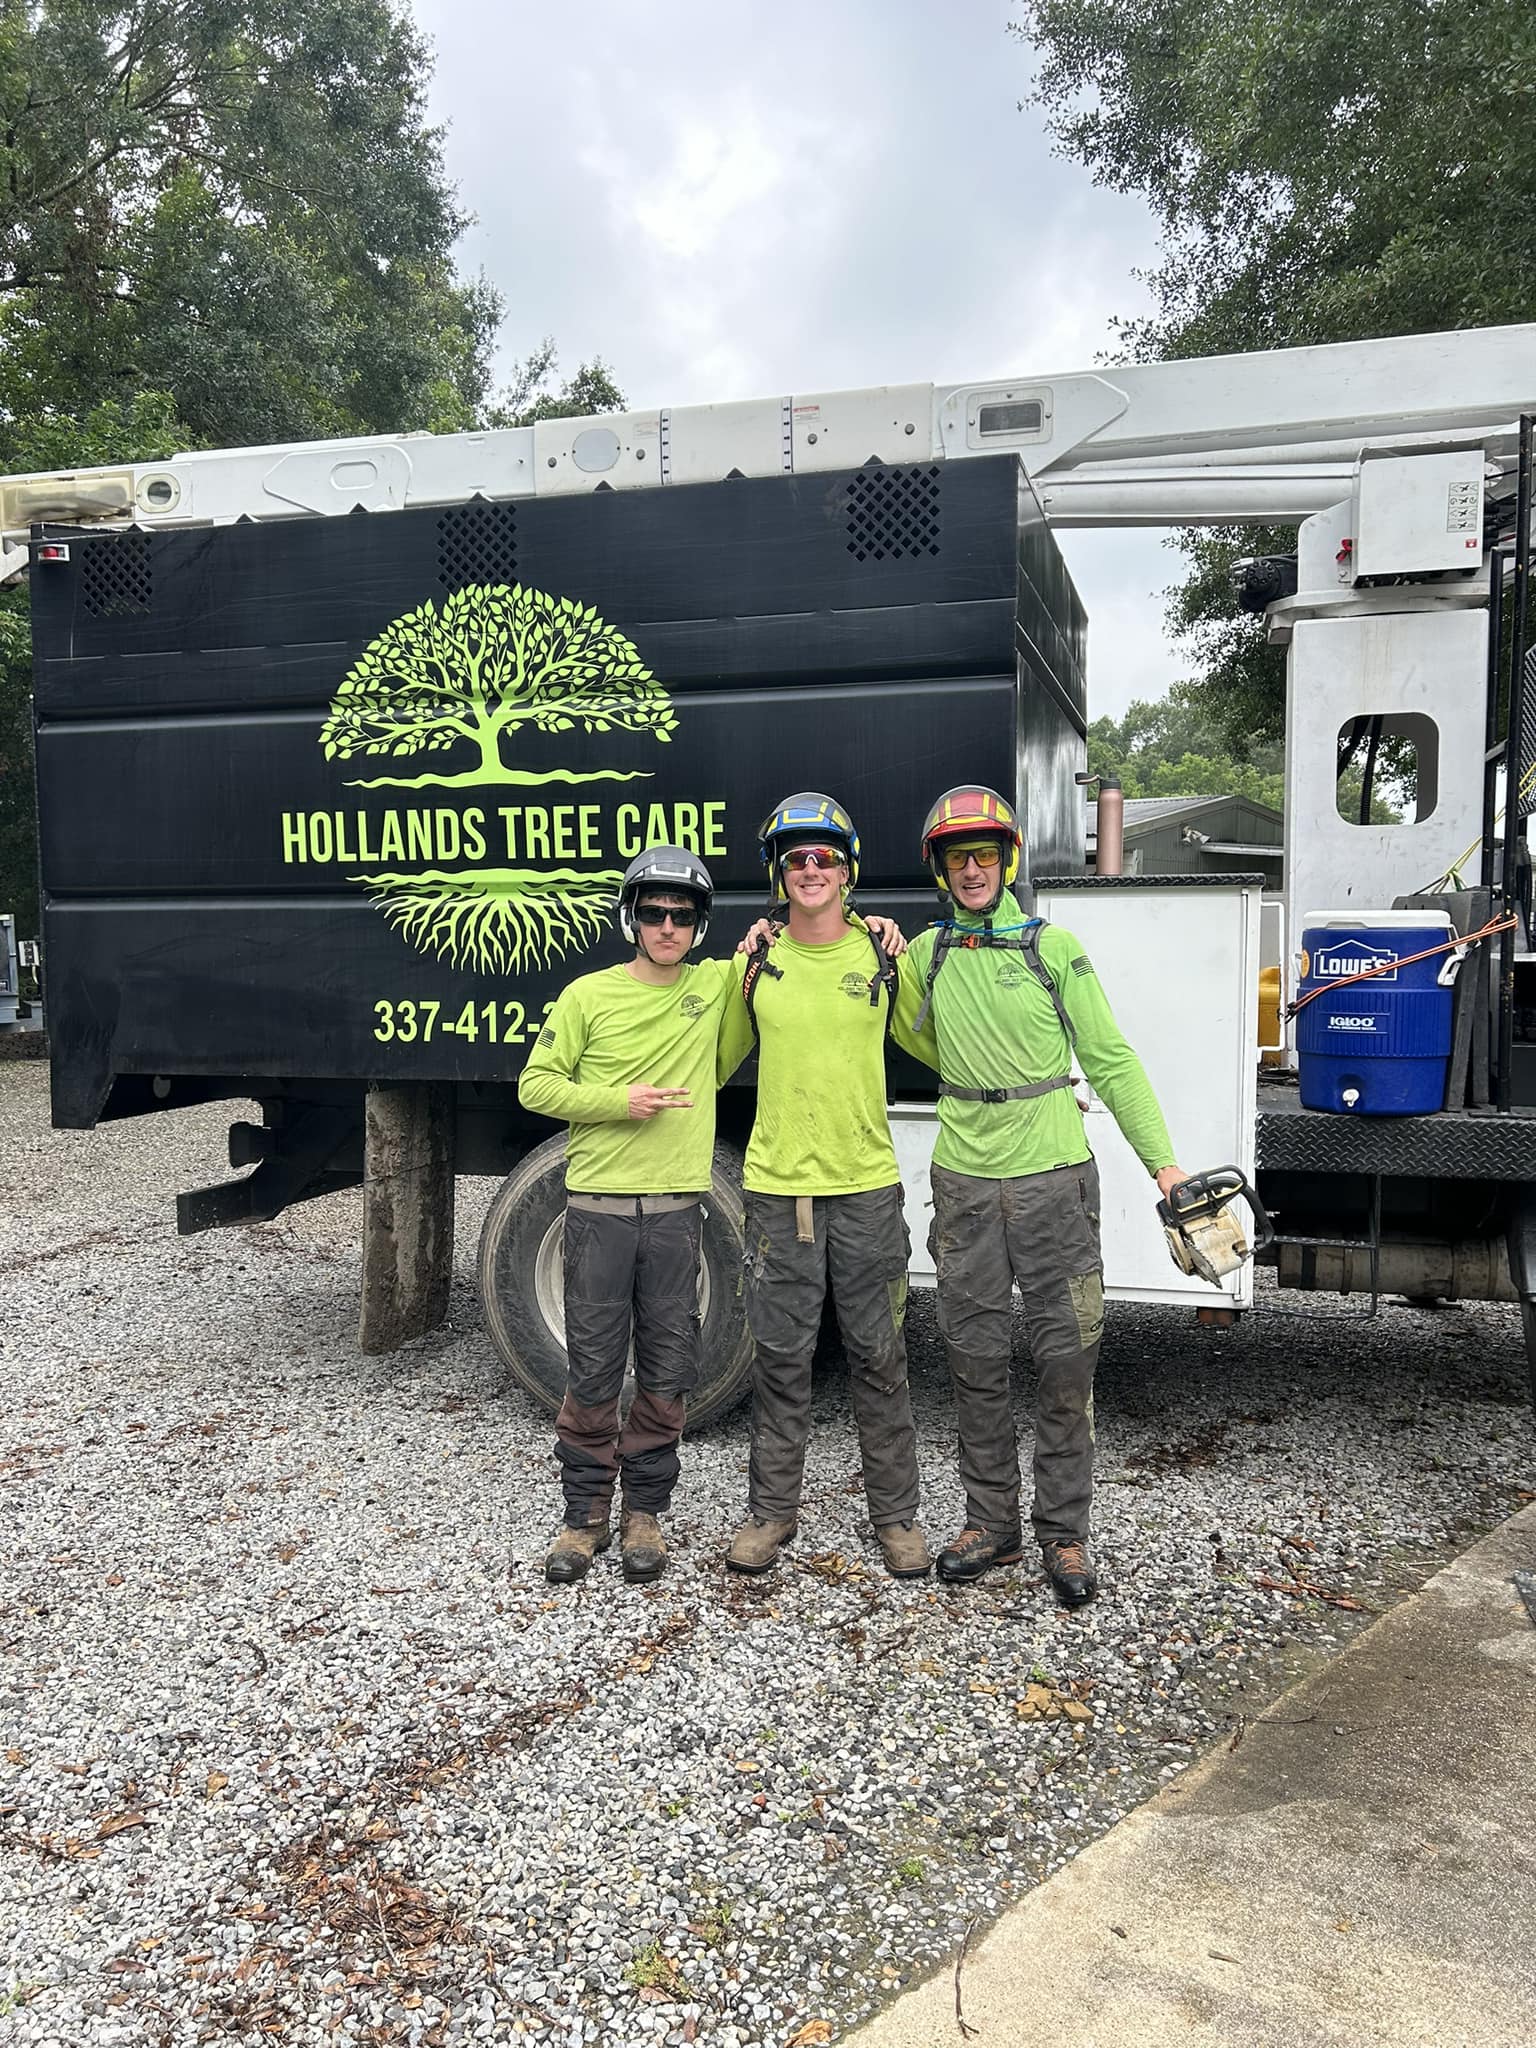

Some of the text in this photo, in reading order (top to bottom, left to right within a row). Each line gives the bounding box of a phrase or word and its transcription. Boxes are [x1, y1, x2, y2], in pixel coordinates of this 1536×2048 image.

[282, 801, 727, 863] HOLLANDS TREE CARE
[373, 1000, 558, 1043] 337-412-
[1330, 1016, 1374, 1027] IGLOO
